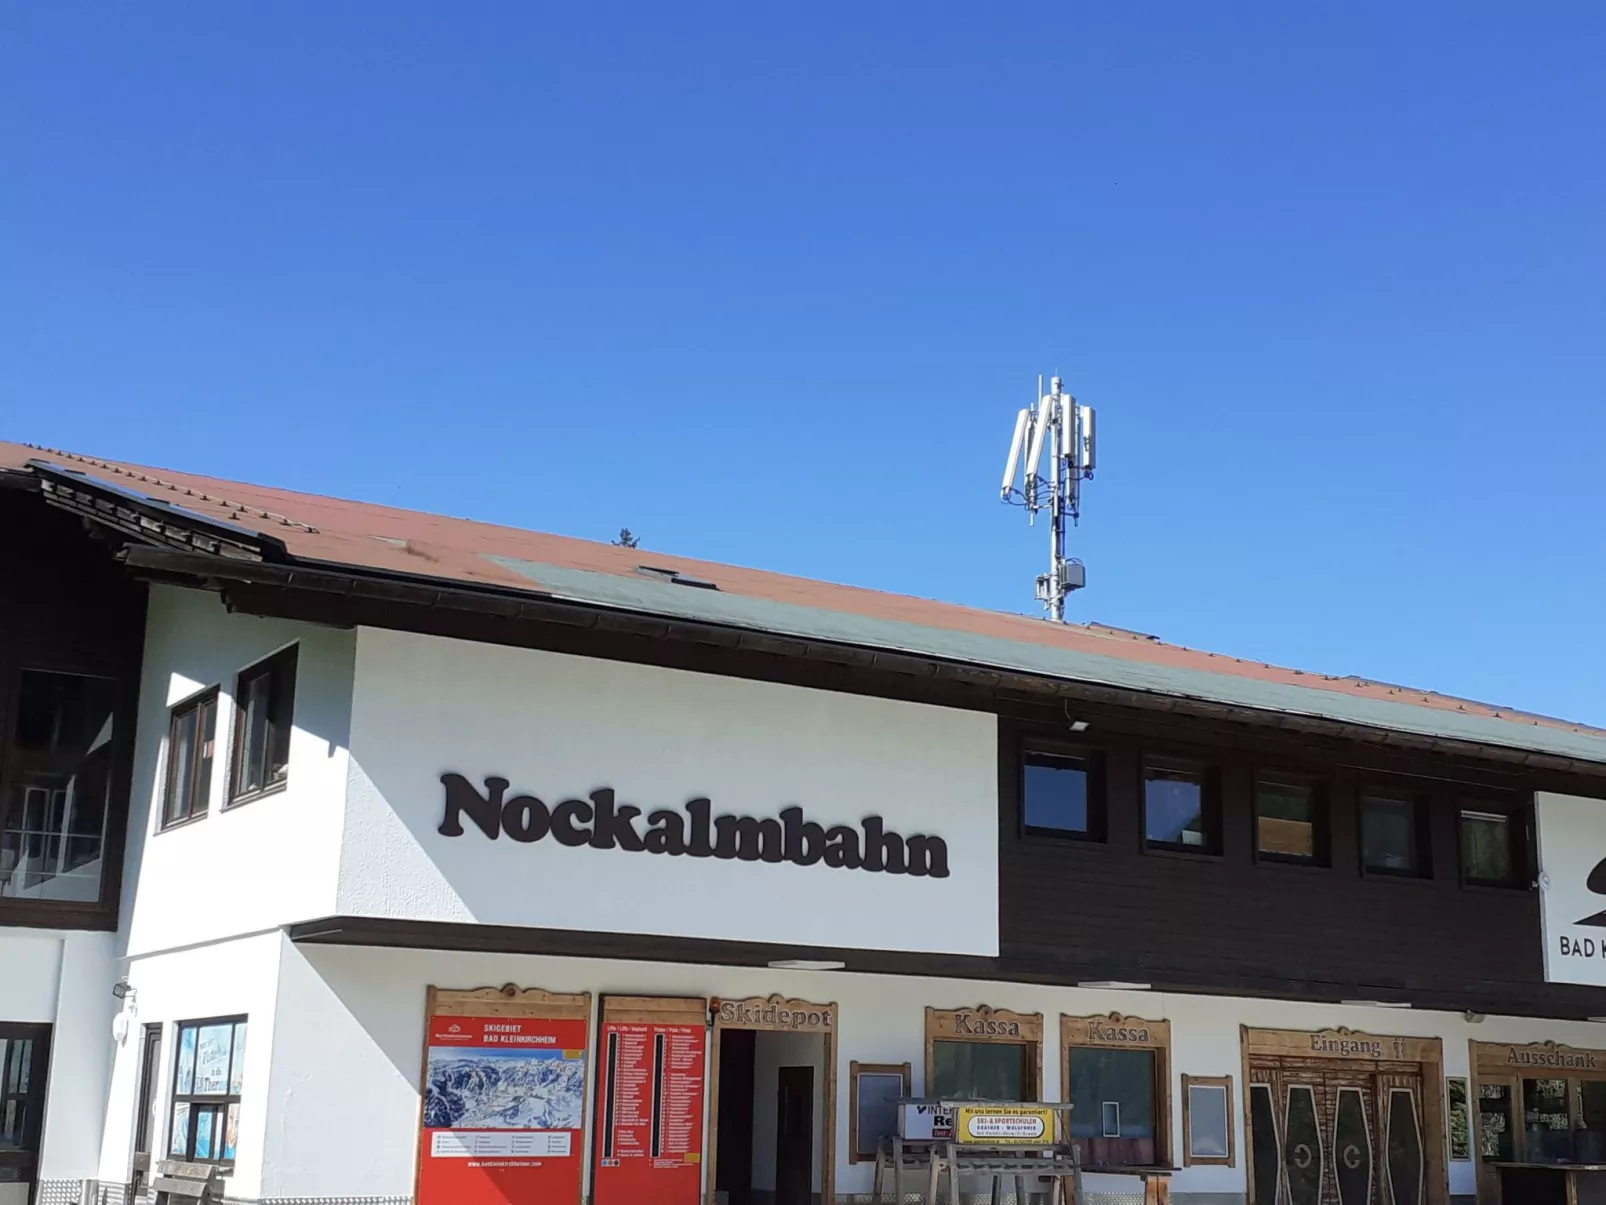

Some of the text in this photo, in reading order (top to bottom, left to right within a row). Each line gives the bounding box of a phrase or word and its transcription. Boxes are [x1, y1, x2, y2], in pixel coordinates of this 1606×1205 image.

[437, 773, 950, 878] Nockalmbahn
[1560, 936, 1595, 957] BAD
[720, 1002, 831, 1029] Skidepot
[954, 1014, 1020, 1036] Kassa
[483, 1034, 499, 1043] BAD
[501, 1035, 557, 1044] KLEINKIRCHHEIM
[484, 1024, 522, 1033] SKIGEBIET
[1088, 1021, 1149, 1042] Kassa
[1310, 1034, 1381, 1057] Eingang
[1507, 1046, 1597, 1068] Ausschank
